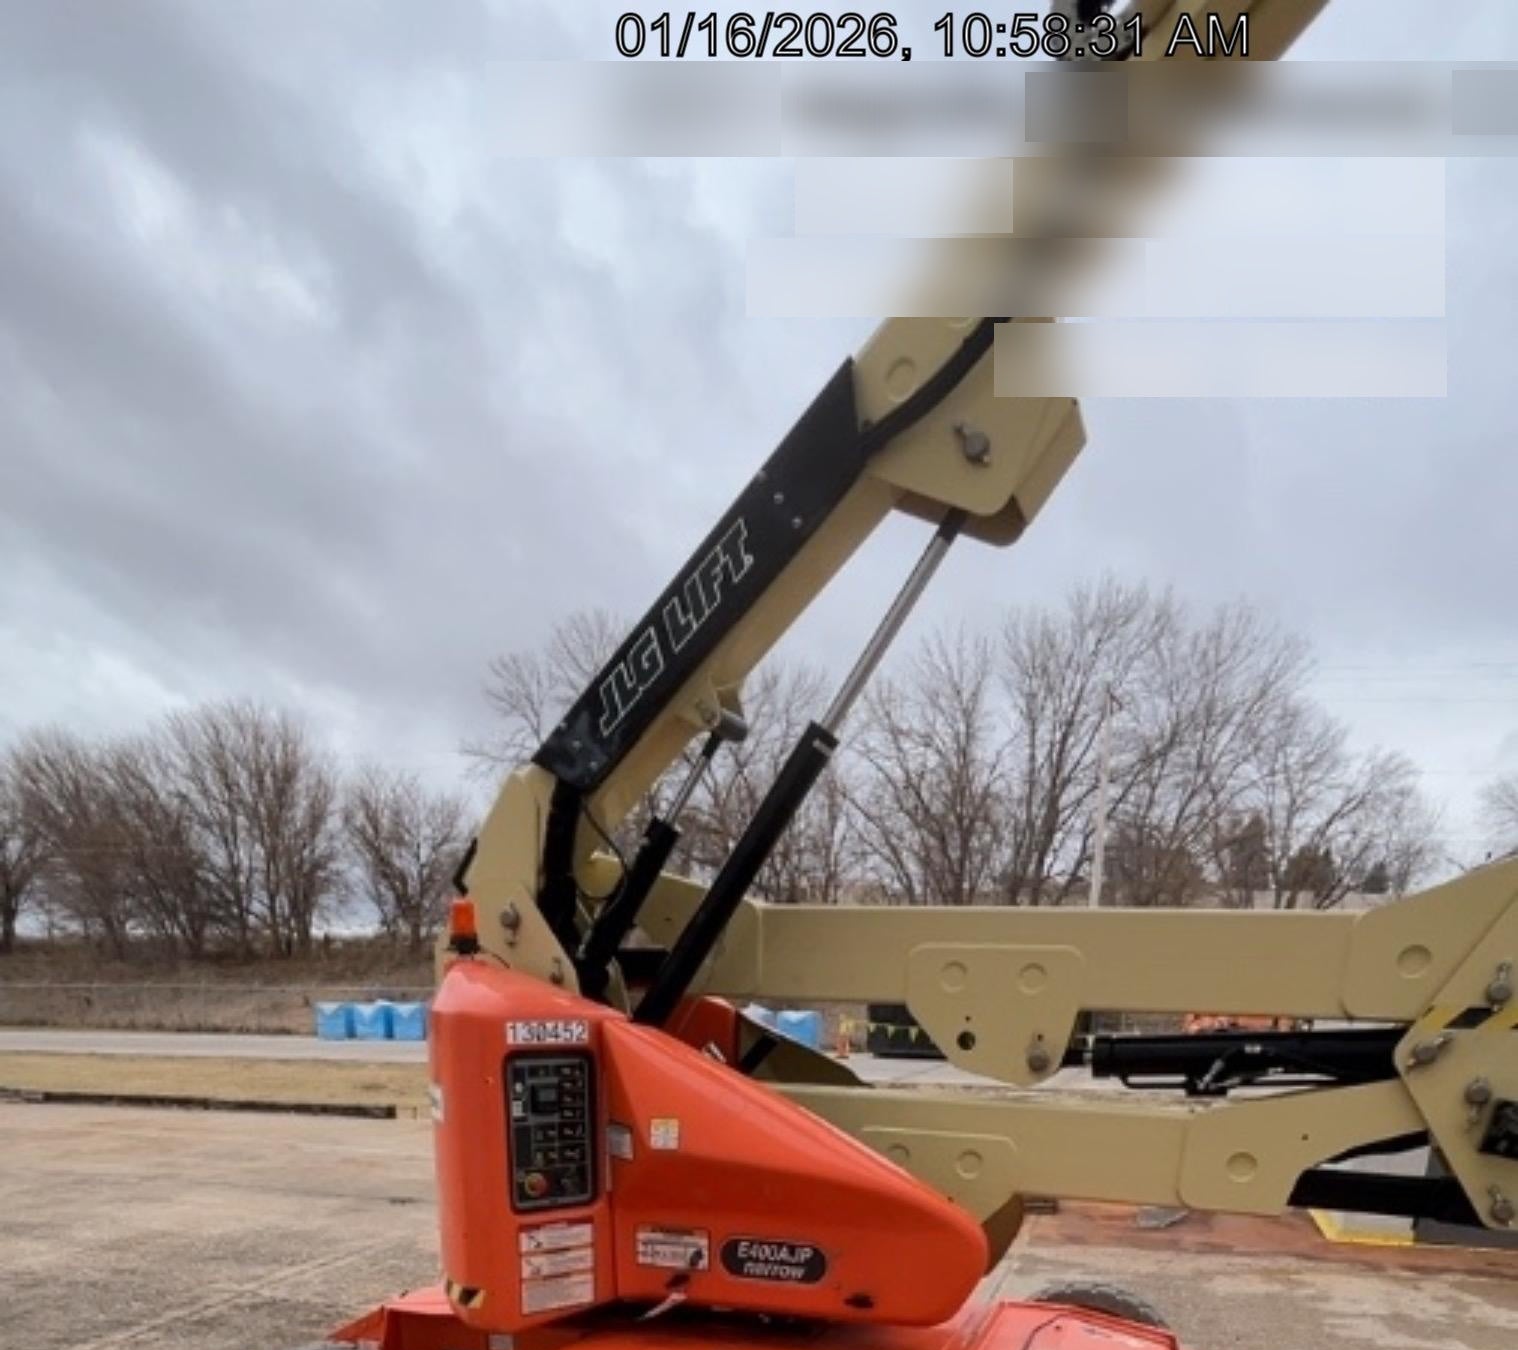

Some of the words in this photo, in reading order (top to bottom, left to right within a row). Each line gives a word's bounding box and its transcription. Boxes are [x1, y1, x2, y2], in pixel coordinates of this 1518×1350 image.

[599, 626, 665, 737] JLG
[662, 518, 754, 654] LIFT
[737, 1241, 813, 1263] E400AJP
